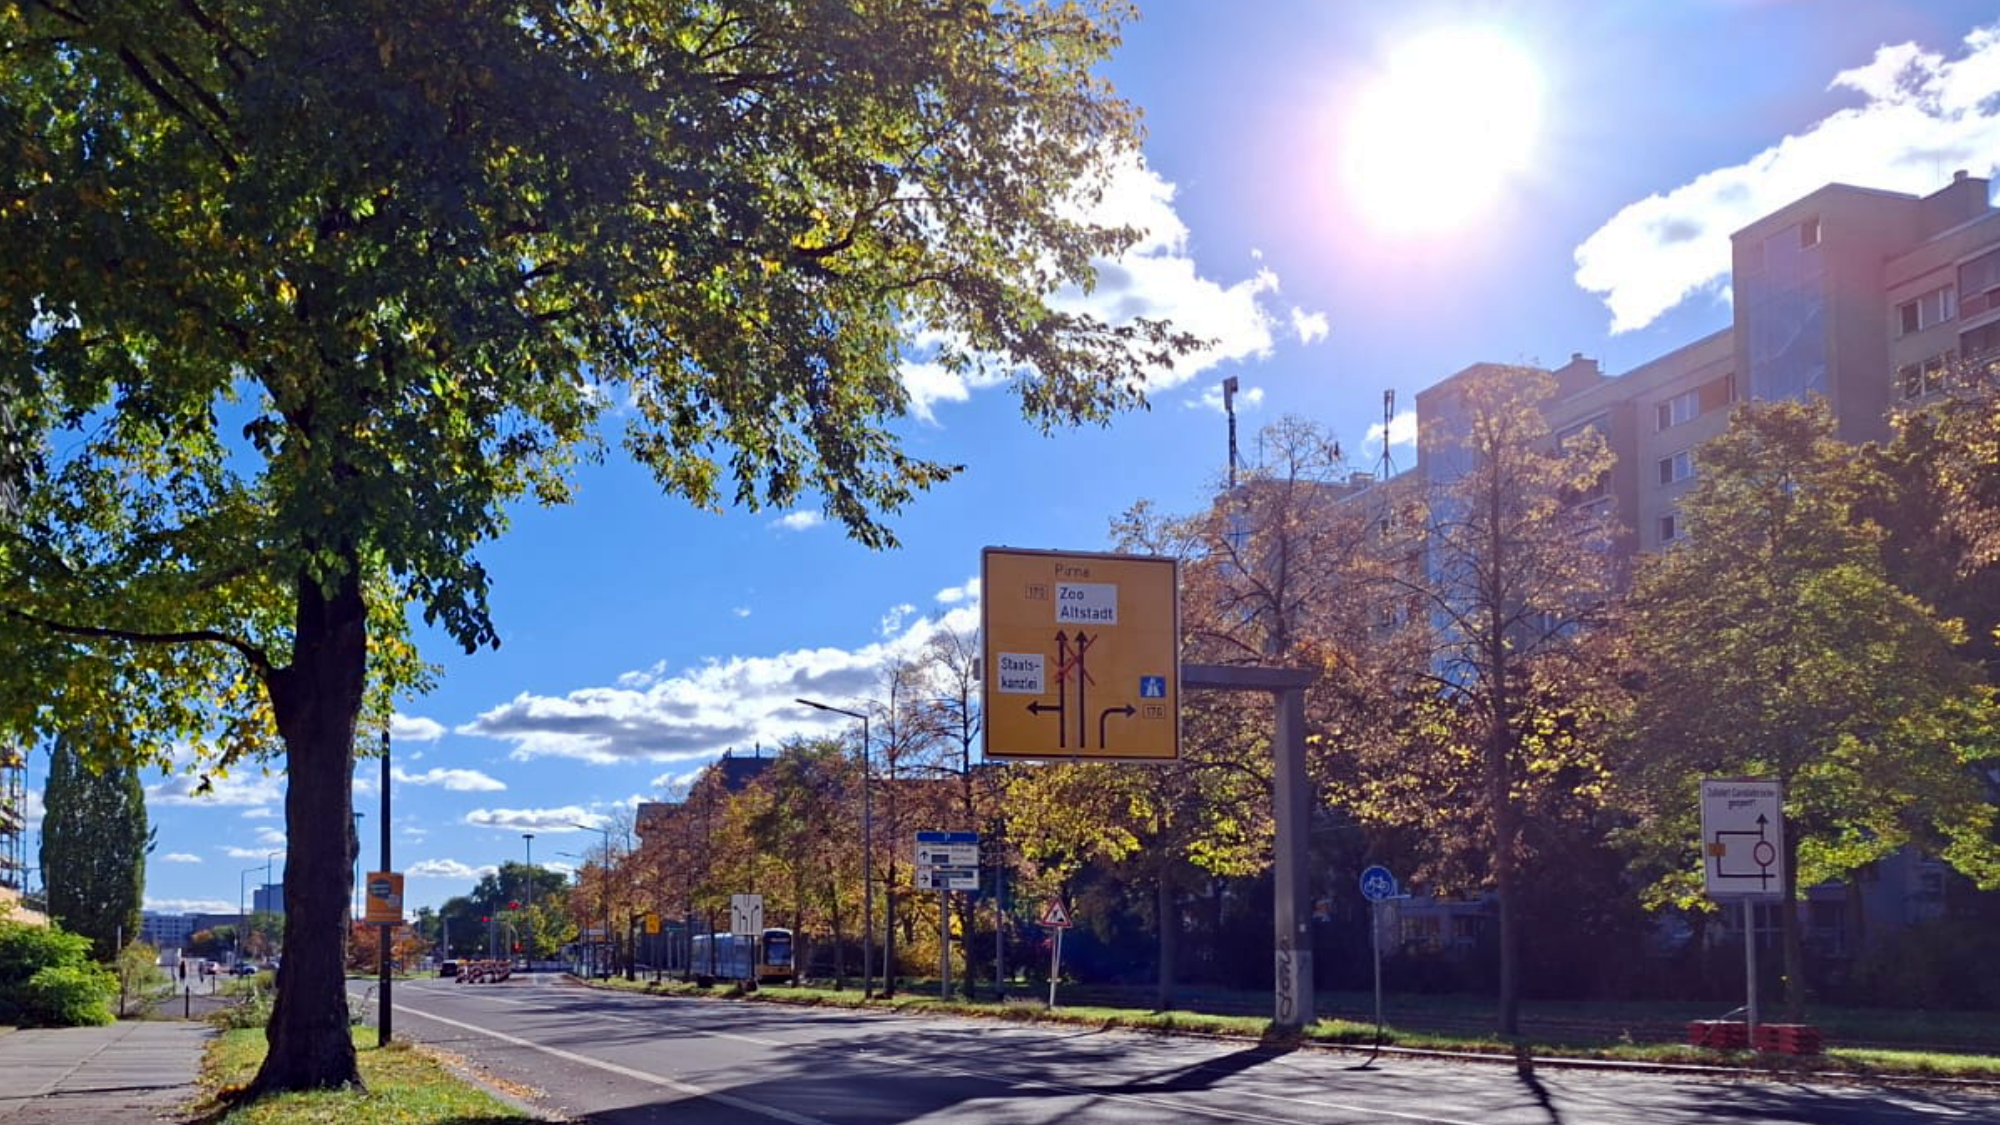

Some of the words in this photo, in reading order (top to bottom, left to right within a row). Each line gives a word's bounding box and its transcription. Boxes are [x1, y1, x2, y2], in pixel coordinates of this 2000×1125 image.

[1060, 587, 1084, 600] Zoo
[1061, 605, 1113, 620] Altstadt
[1001, 657, 1041, 671] Staats-
[1001, 676, 1038, 690] kanzlei
